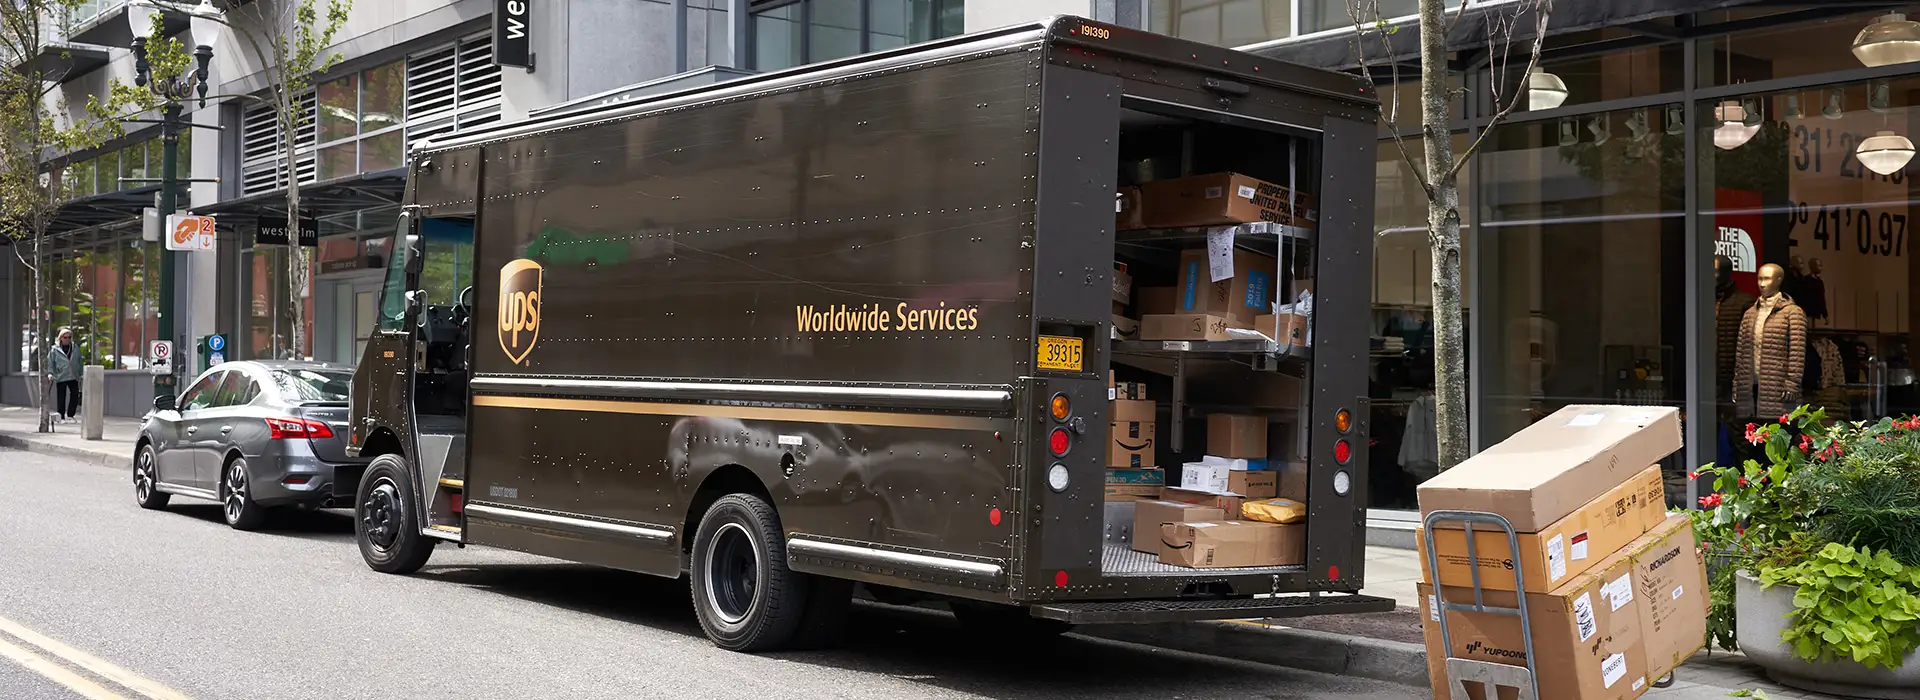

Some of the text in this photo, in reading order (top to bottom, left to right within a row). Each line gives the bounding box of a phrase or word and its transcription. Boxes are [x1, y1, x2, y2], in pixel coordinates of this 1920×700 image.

[1081, 25, 1110, 39] 191390
[1256, 182, 1297, 202] PROPERT
[203, 219, 211, 232] 2
[1260, 209, 1290, 225] SERVICE
[261, 226, 289, 237] west
[1719, 226, 1738, 242] THE
[1714, 240, 1738, 257] ORTH
[502, 291, 538, 348] ups
[796, 301, 978, 332] Worldwide Services
[1047, 343, 1081, 363] 39315
[1650, 546, 1681, 572] RICHARDSON
